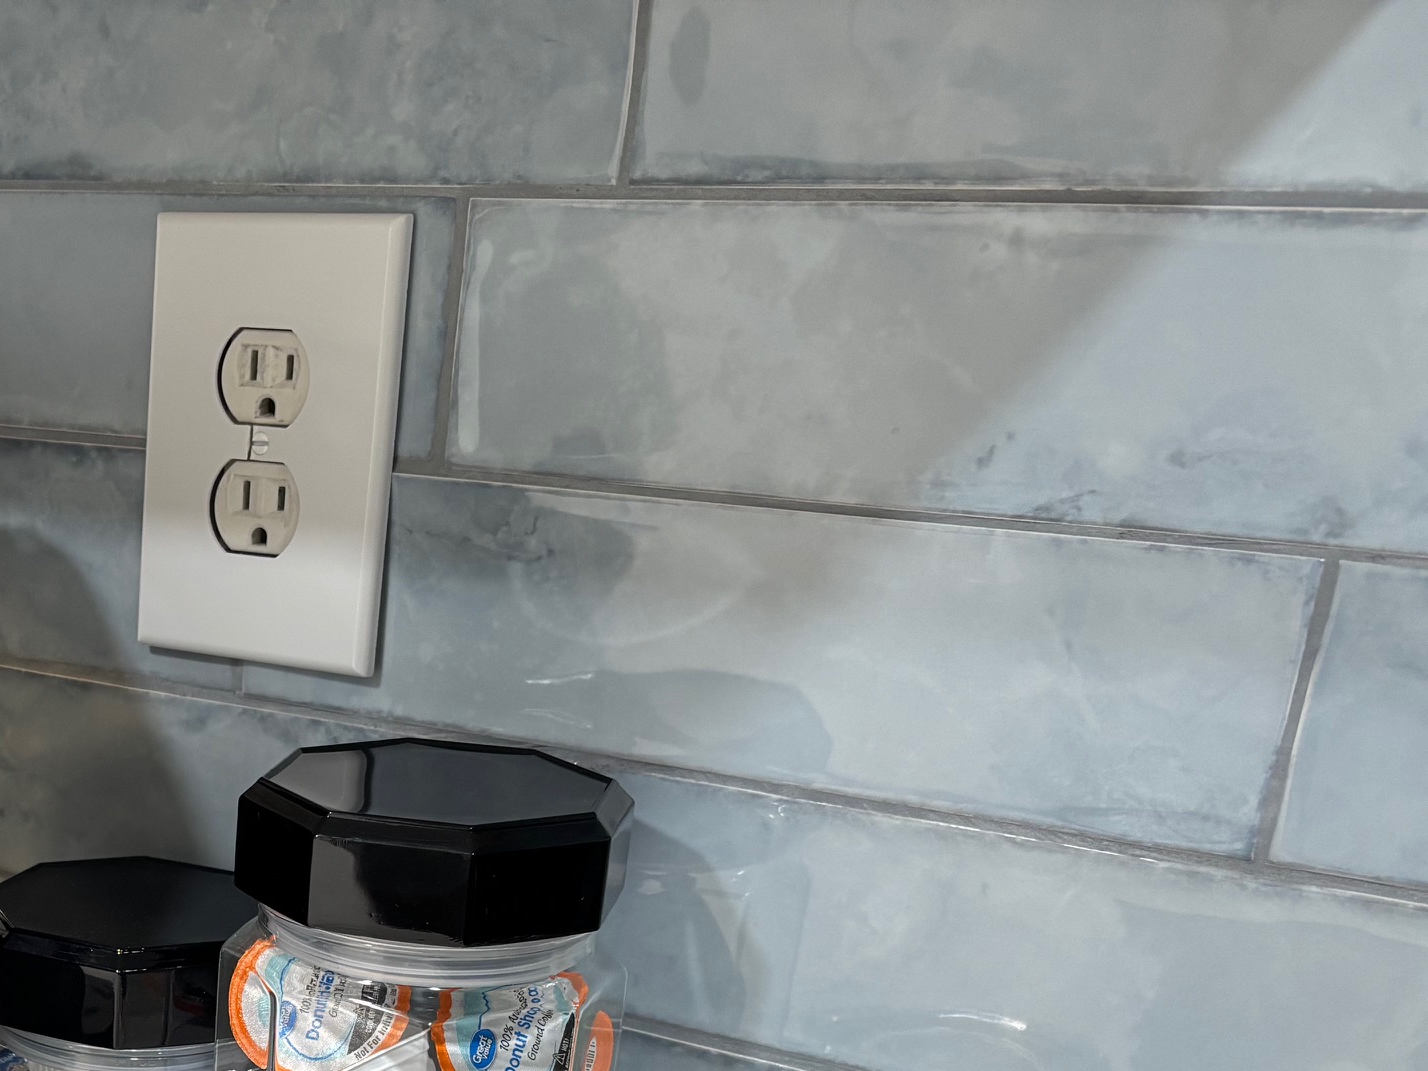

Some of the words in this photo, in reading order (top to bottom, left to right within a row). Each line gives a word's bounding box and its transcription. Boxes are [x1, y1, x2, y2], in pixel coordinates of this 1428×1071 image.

[354, 1048, 369, 1060] Not
[367, 1036, 382, 1048] For
[473, 1035, 487, 1063] Great
[482, 1039, 493, 1059] Value
[500, 1024, 514, 1051] 100%
[527, 1026, 545, 1061] Ground
